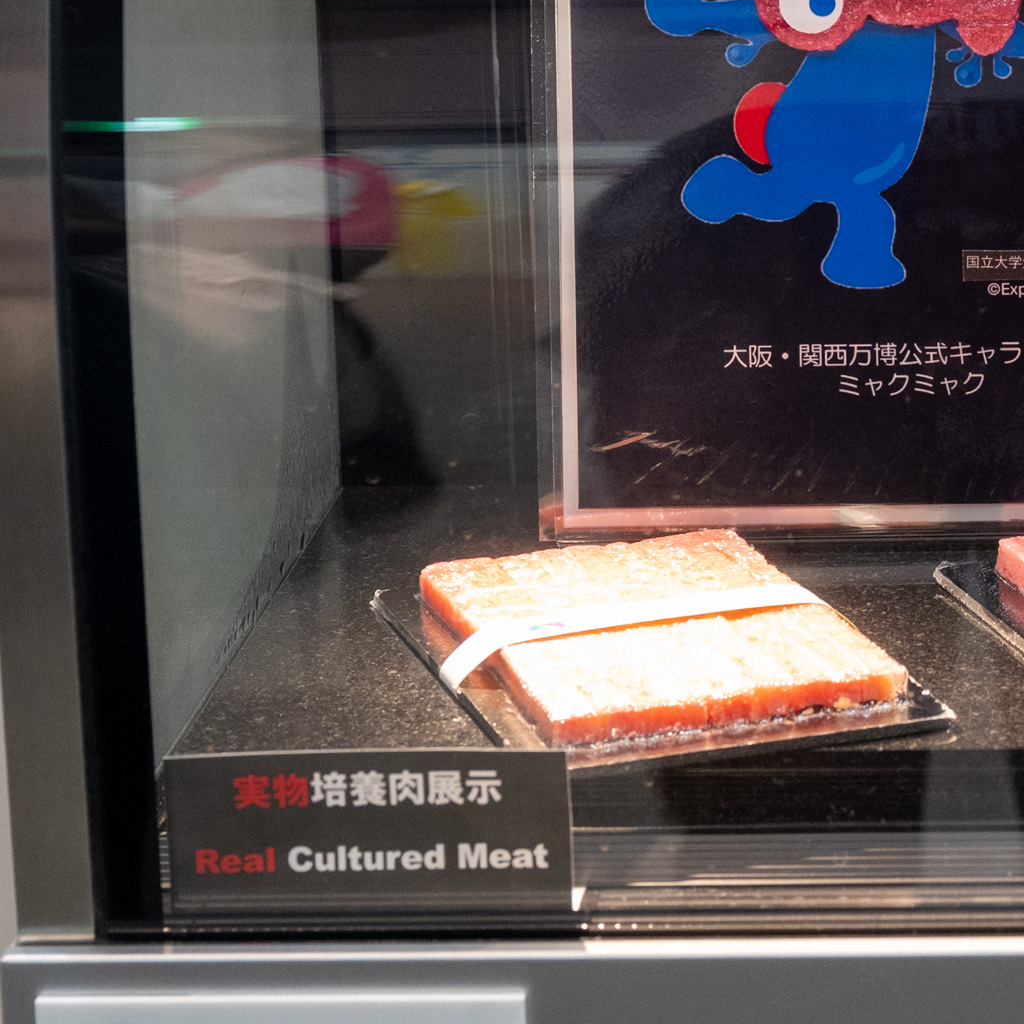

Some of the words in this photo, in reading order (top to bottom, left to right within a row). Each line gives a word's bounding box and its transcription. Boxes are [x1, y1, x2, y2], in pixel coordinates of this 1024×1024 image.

[838, 372, 985, 397] ミャクミャク
[233, 769, 502, 810] 実物培養肉展示
[195, 847, 276, 874] Real
[287, 843, 445, 873] Cultured
[457, 842, 549, 870] Meat
